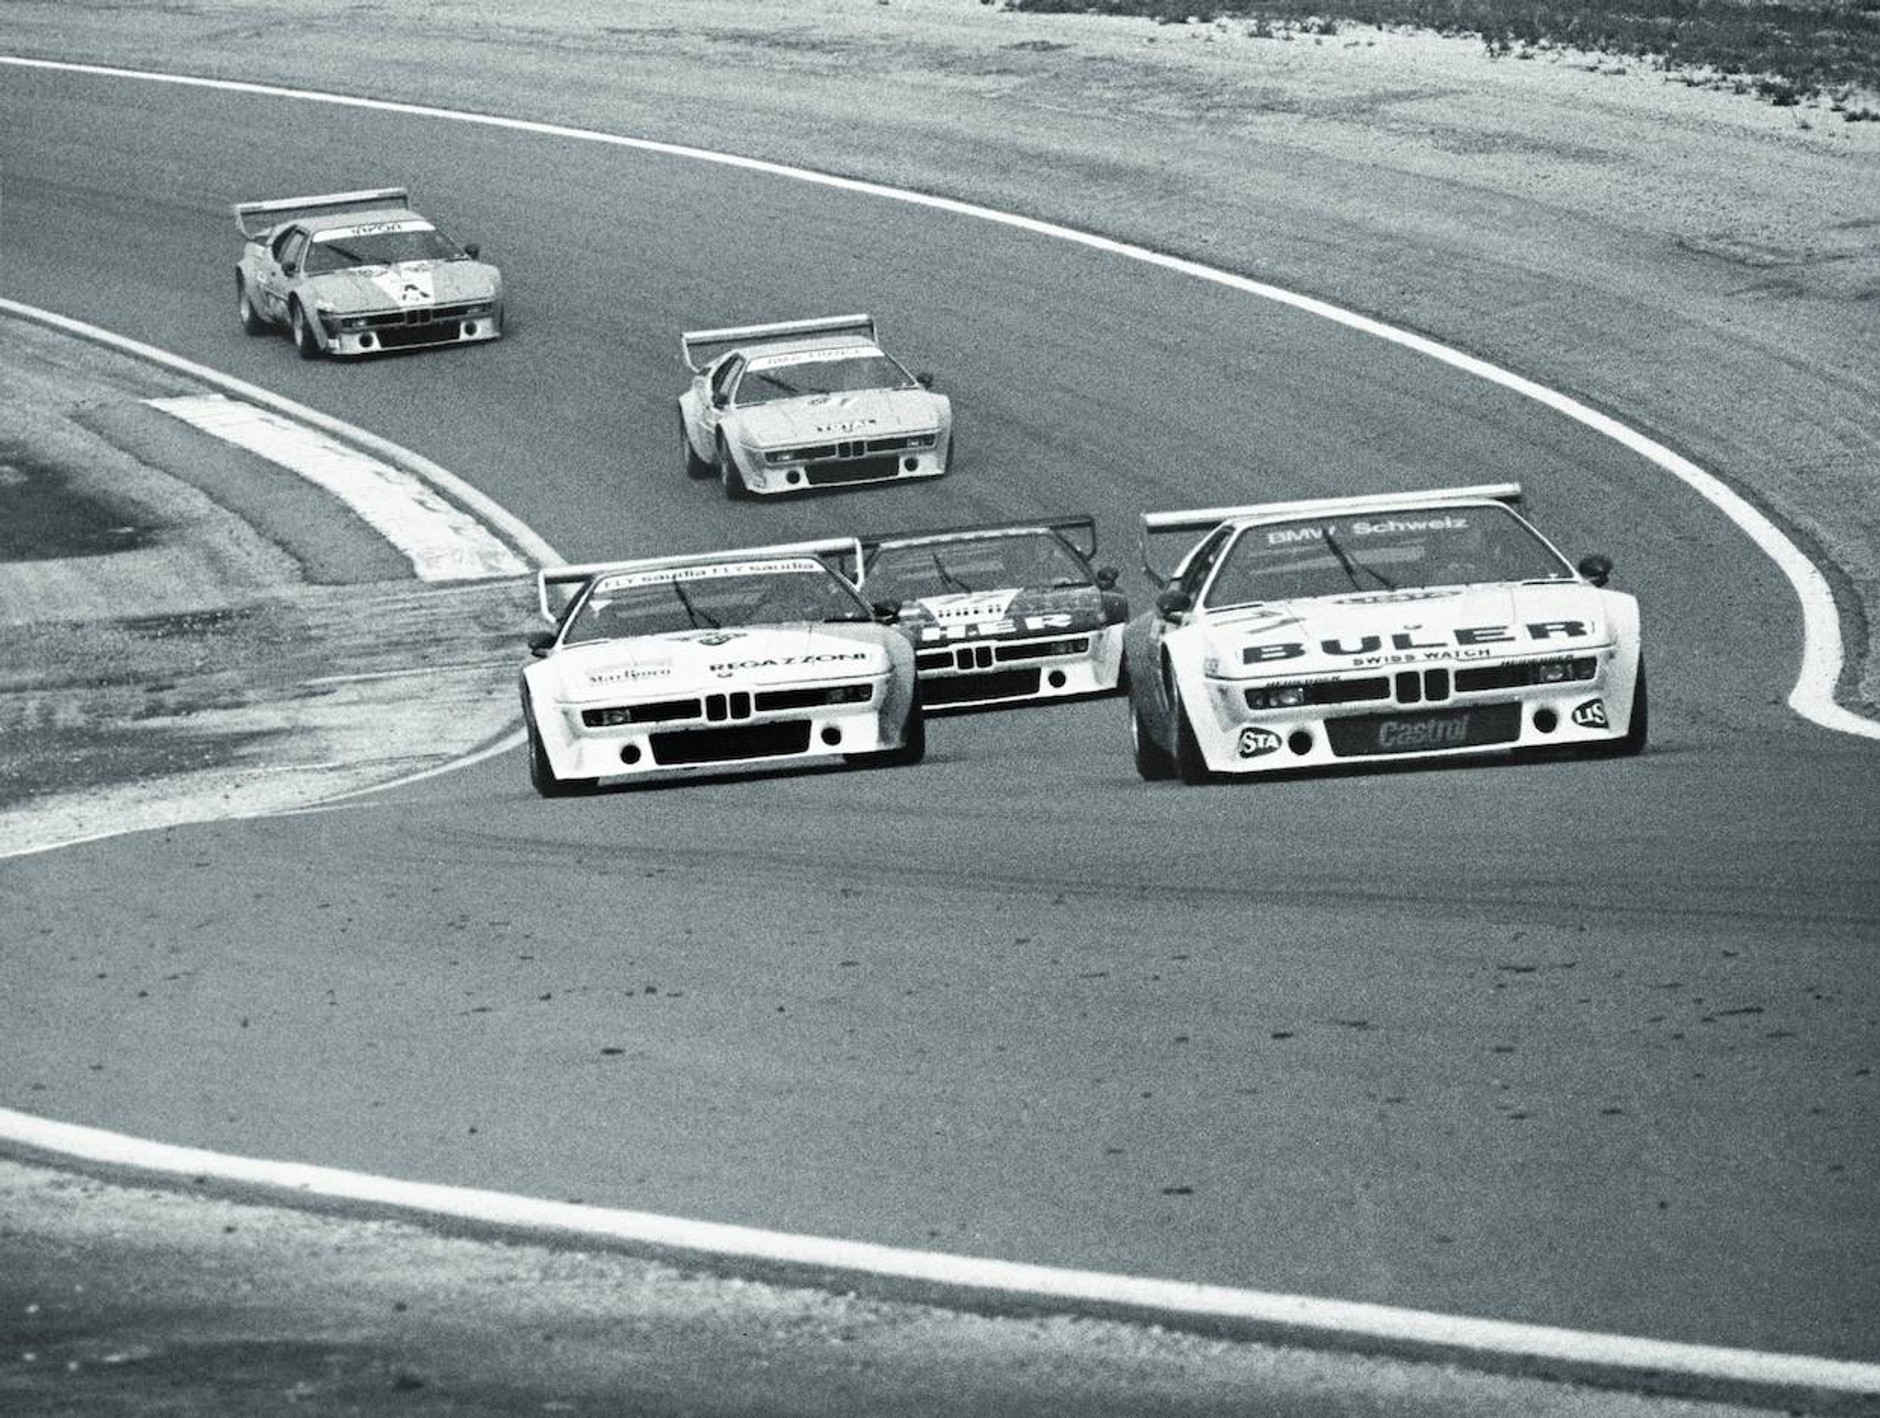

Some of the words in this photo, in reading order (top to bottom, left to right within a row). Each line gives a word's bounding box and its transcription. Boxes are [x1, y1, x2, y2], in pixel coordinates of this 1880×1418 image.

[1267, 526, 1336, 546] BMW
[1353, 515, 1470, 537] Schweiz
[1243, 621, 1588, 664] BULER
[709, 653, 867, 672] REGAZZONI
[1352, 653, 1416, 667] SWISS
[1423, 648, 1491, 661] WATCH
[1241, 731, 1280, 754] STA
[1378, 715, 1471, 747] Castrol
